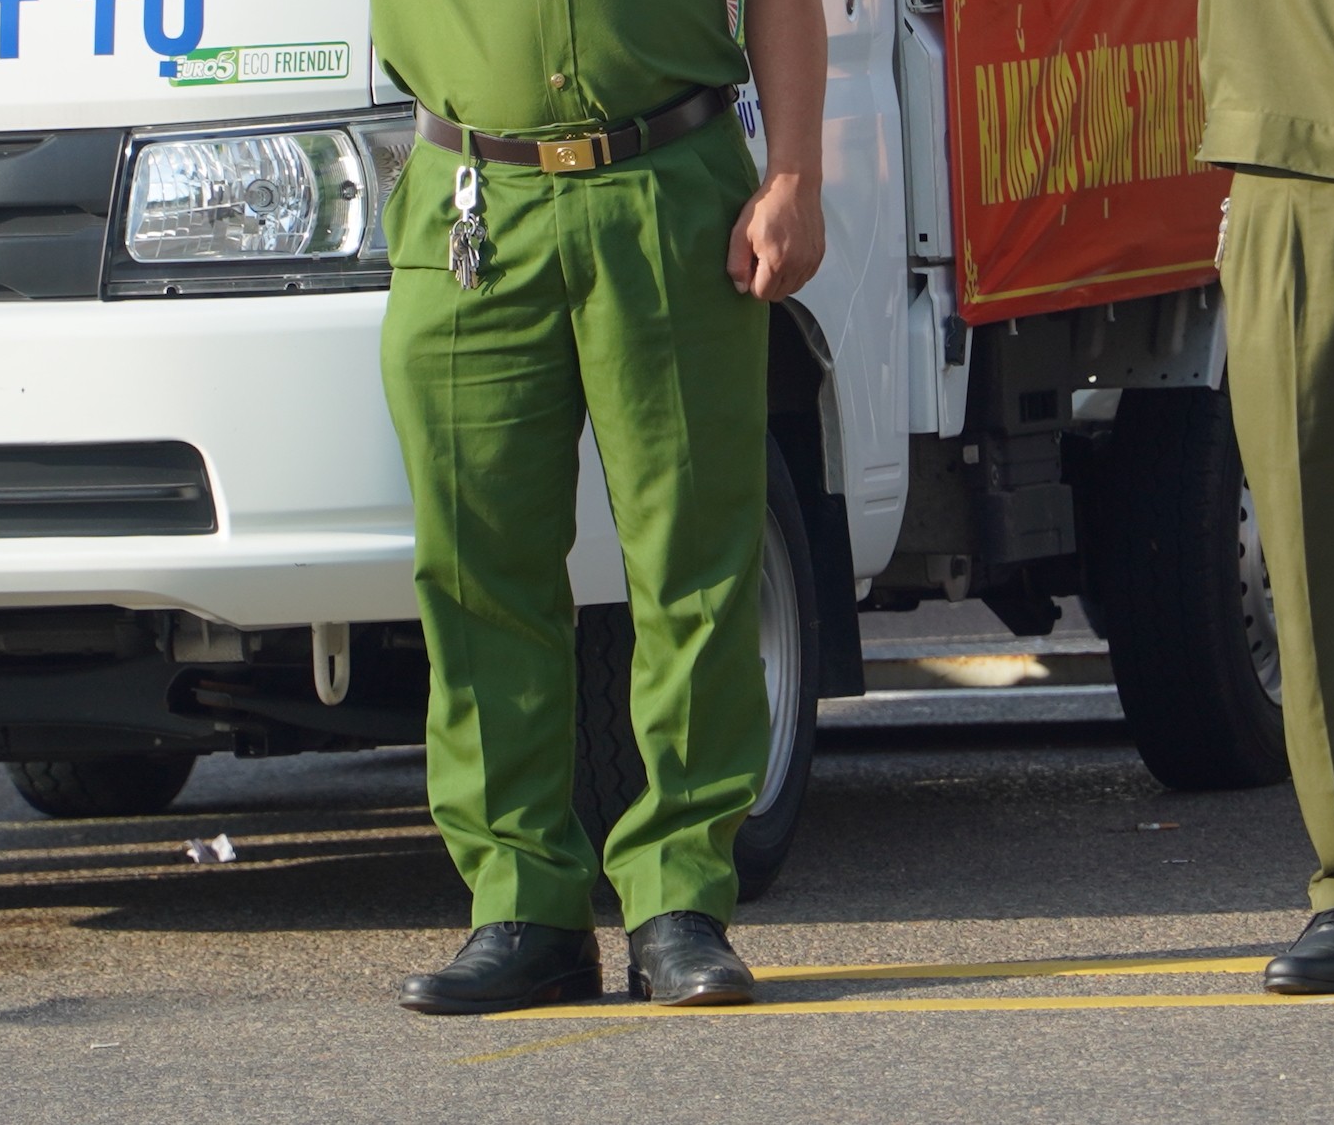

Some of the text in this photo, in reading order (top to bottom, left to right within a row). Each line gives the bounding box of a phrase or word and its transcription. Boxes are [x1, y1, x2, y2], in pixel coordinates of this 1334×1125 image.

[243, 53, 270, 75] ECO
[275, 49, 344, 74] FRIENDLY
[975, 64, 1004, 205] RA
[1133, 40, 1182, 180] THAM
